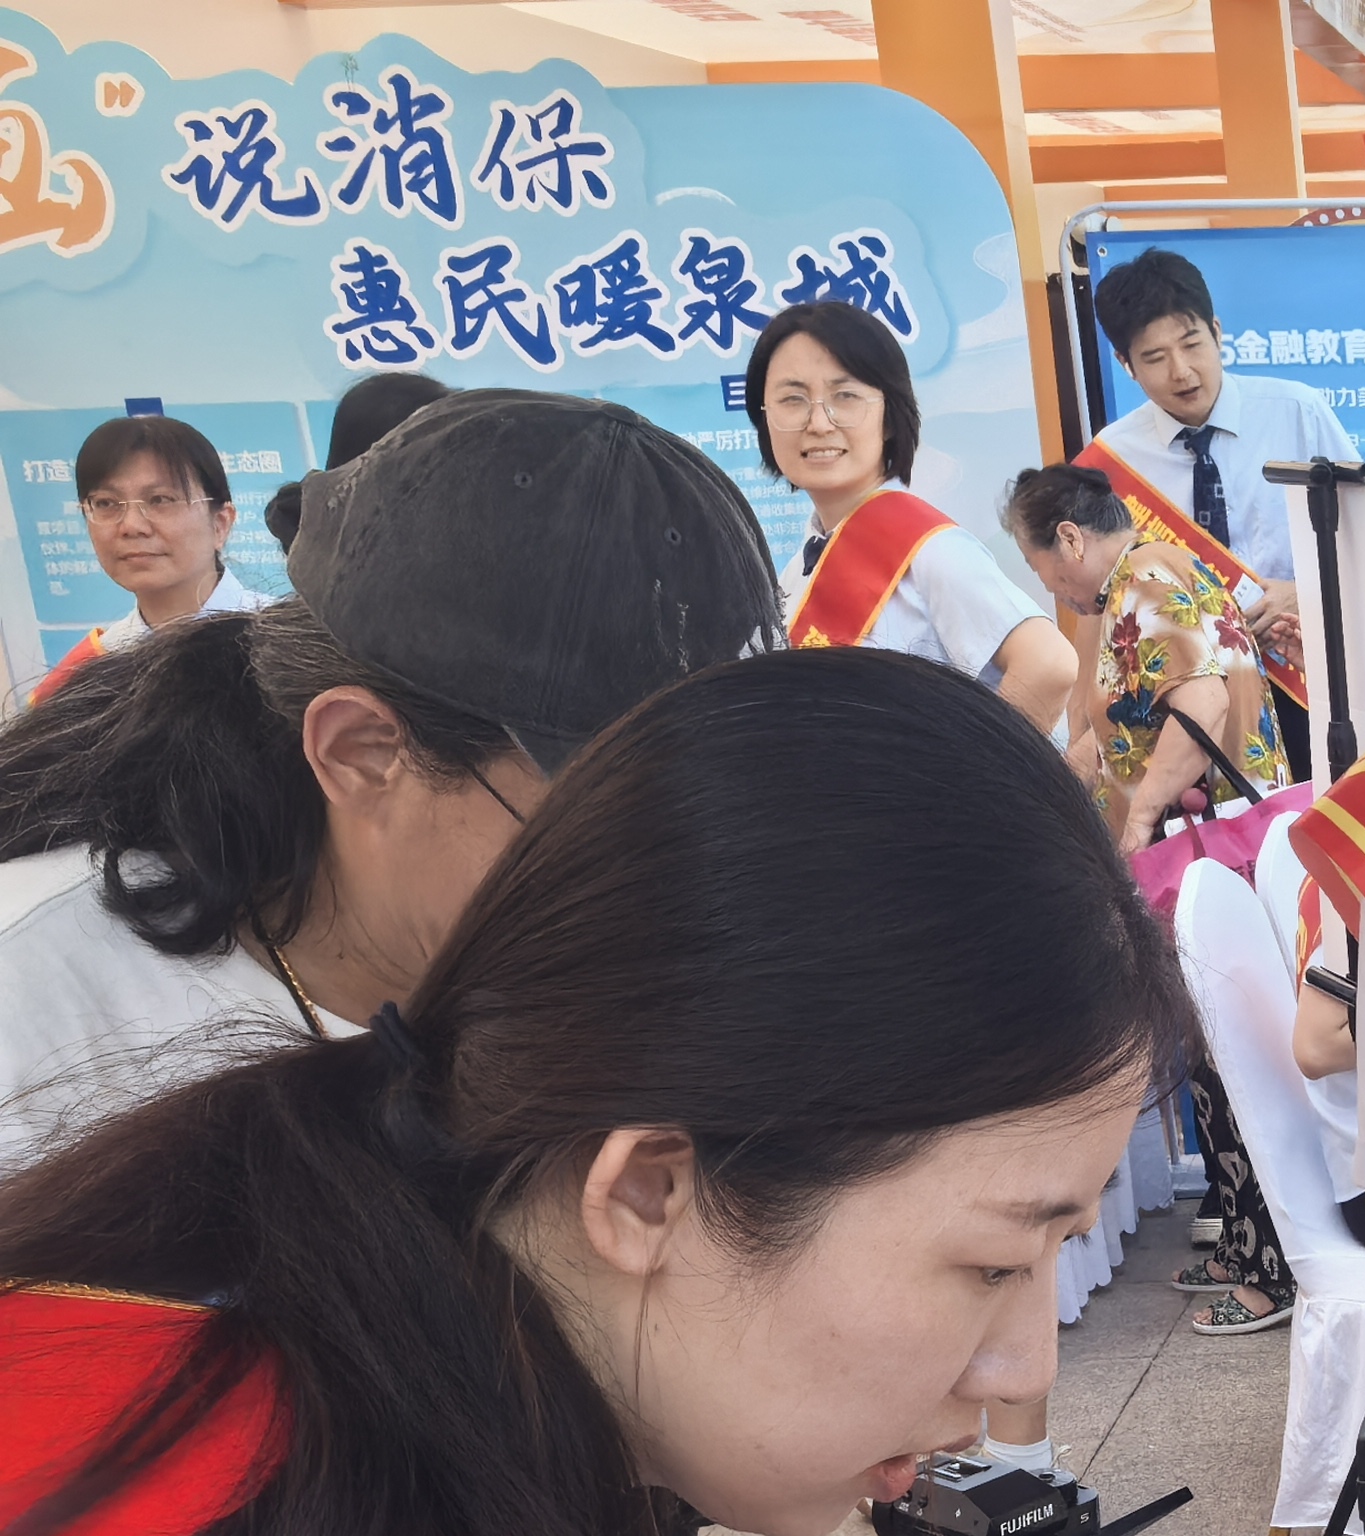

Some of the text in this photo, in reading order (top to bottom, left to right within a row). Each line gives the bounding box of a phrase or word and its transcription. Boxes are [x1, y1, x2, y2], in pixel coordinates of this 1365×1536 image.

[171, 69, 608, 222] 说消保
[331, 233, 913, 367] 惠民暖泉城
[1000, 1503, 1054, 1536] FUJIFILM
